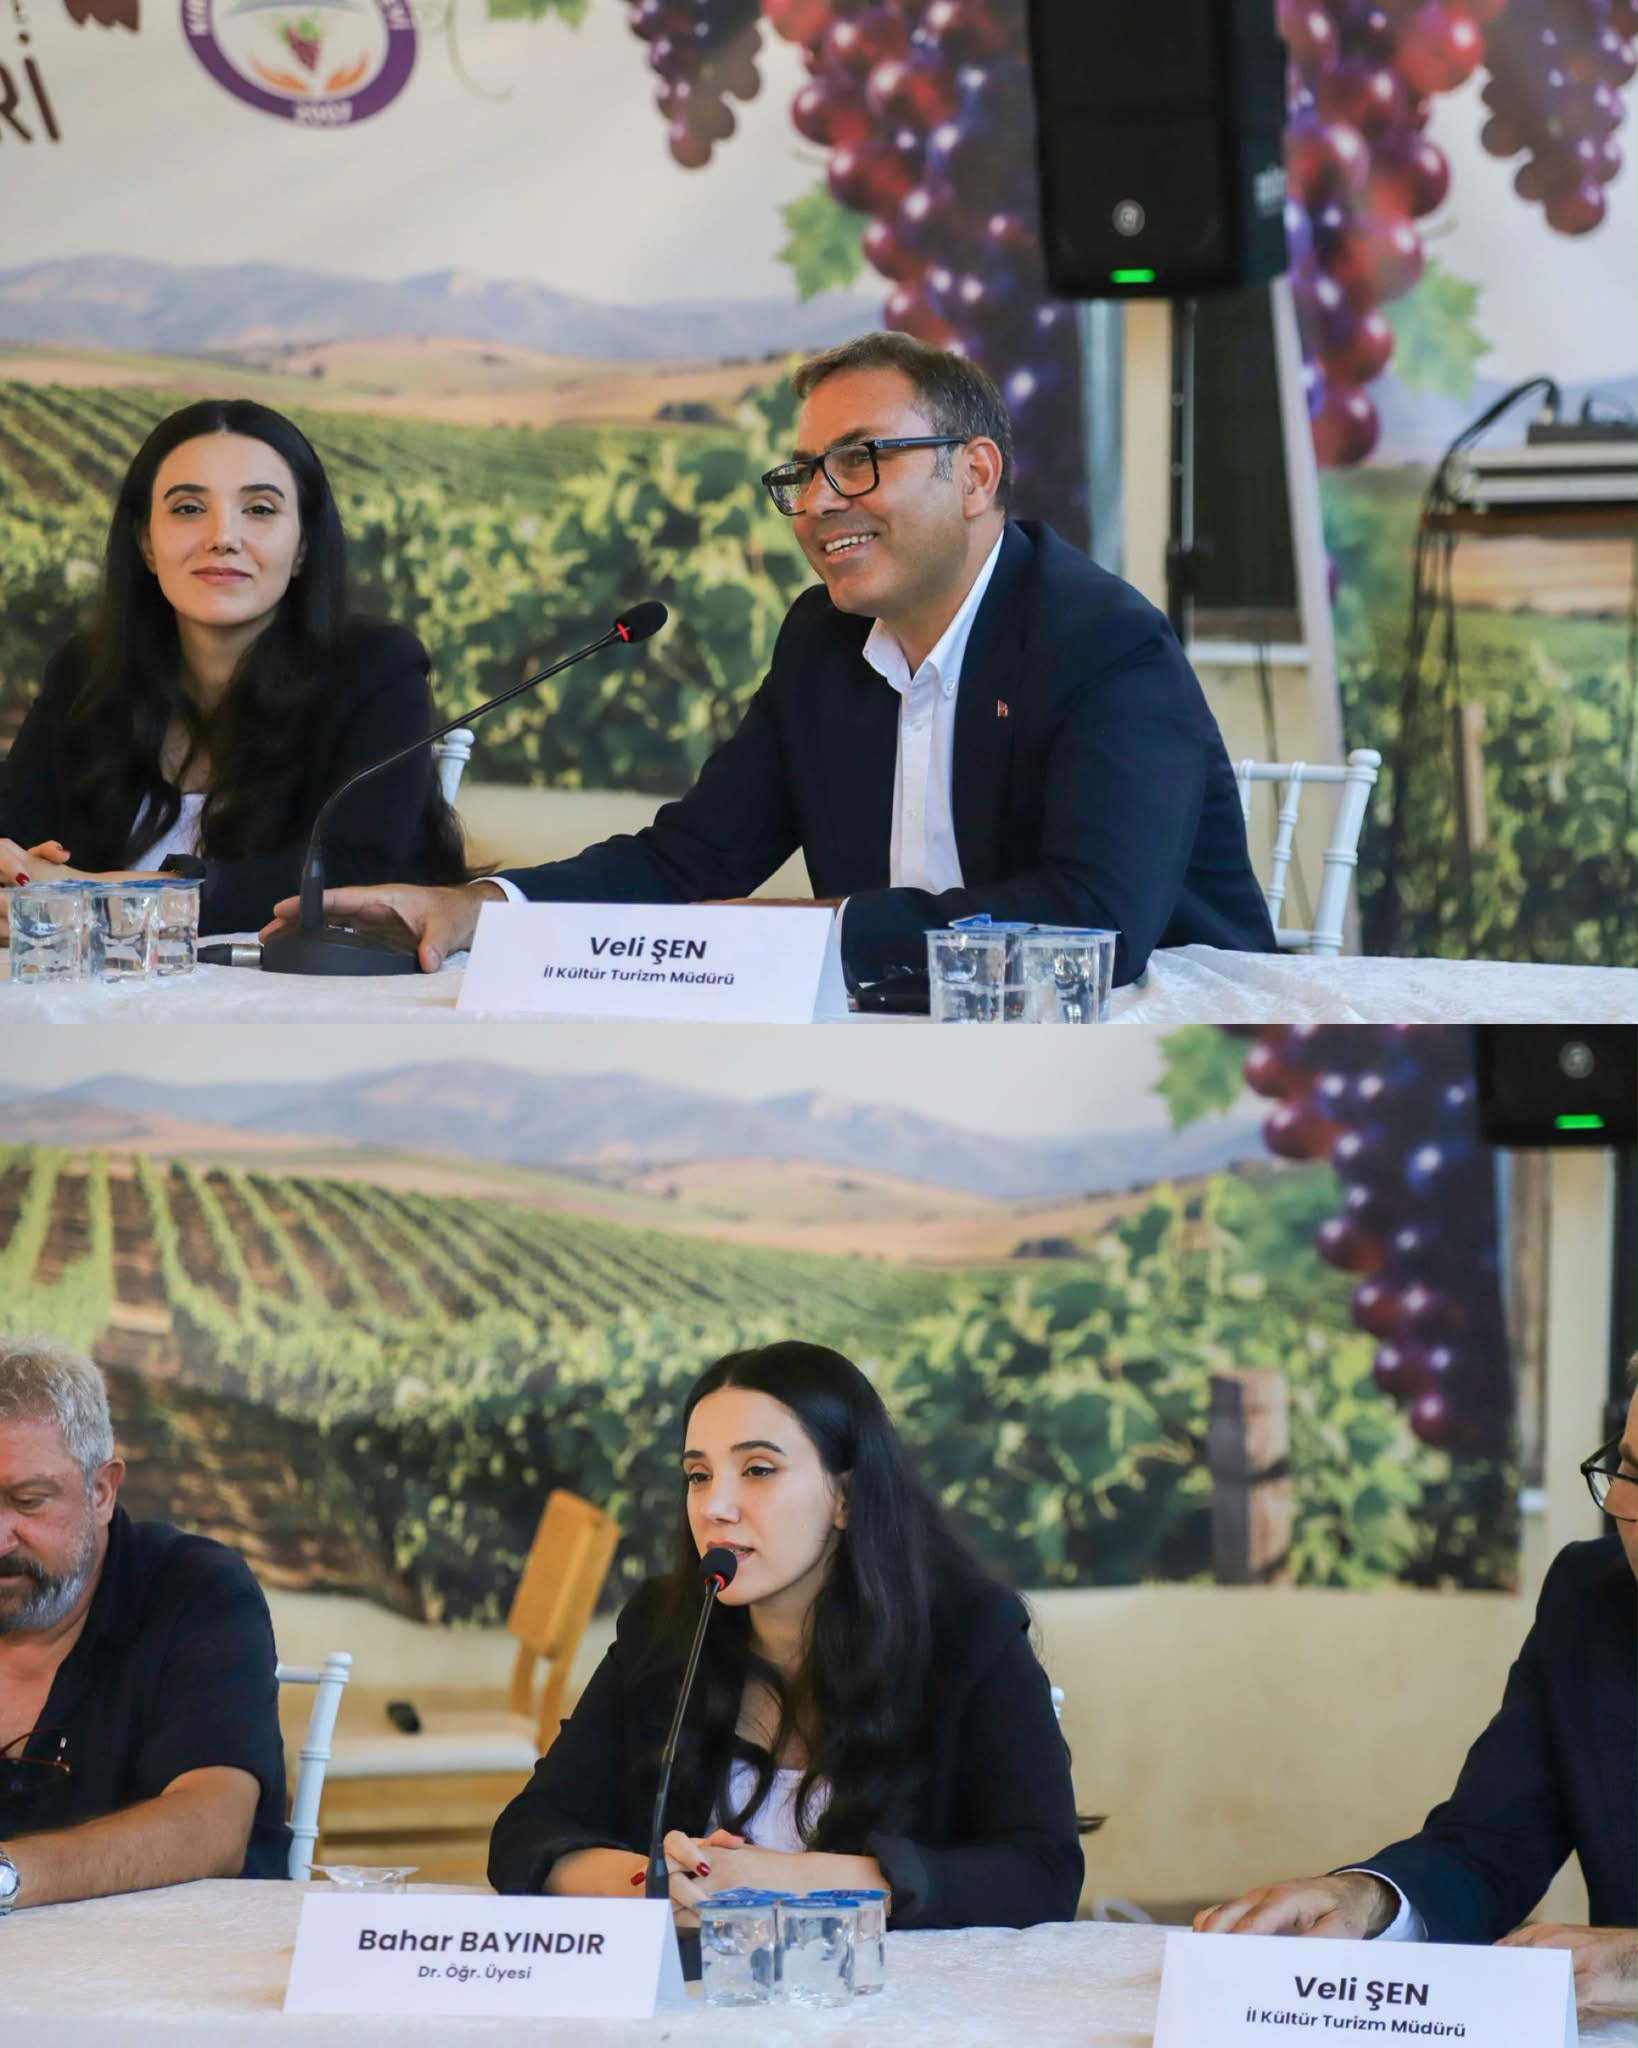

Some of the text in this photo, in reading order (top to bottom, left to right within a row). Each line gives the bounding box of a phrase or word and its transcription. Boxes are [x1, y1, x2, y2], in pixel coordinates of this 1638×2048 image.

[590, 935, 708, 965] Veli ŞEN
[543, 964, 735, 986] İl Kültür Turizm Müdürü
[358, 1928, 606, 1956] Bahar BAYINDIR
[418, 1962, 533, 1983] Dr. Öğr. Üyesi
[1294, 1975, 1430, 2011] Veli ŞEN
[1246, 2006, 1467, 2038] İl Kültür Turizm Müdürü
